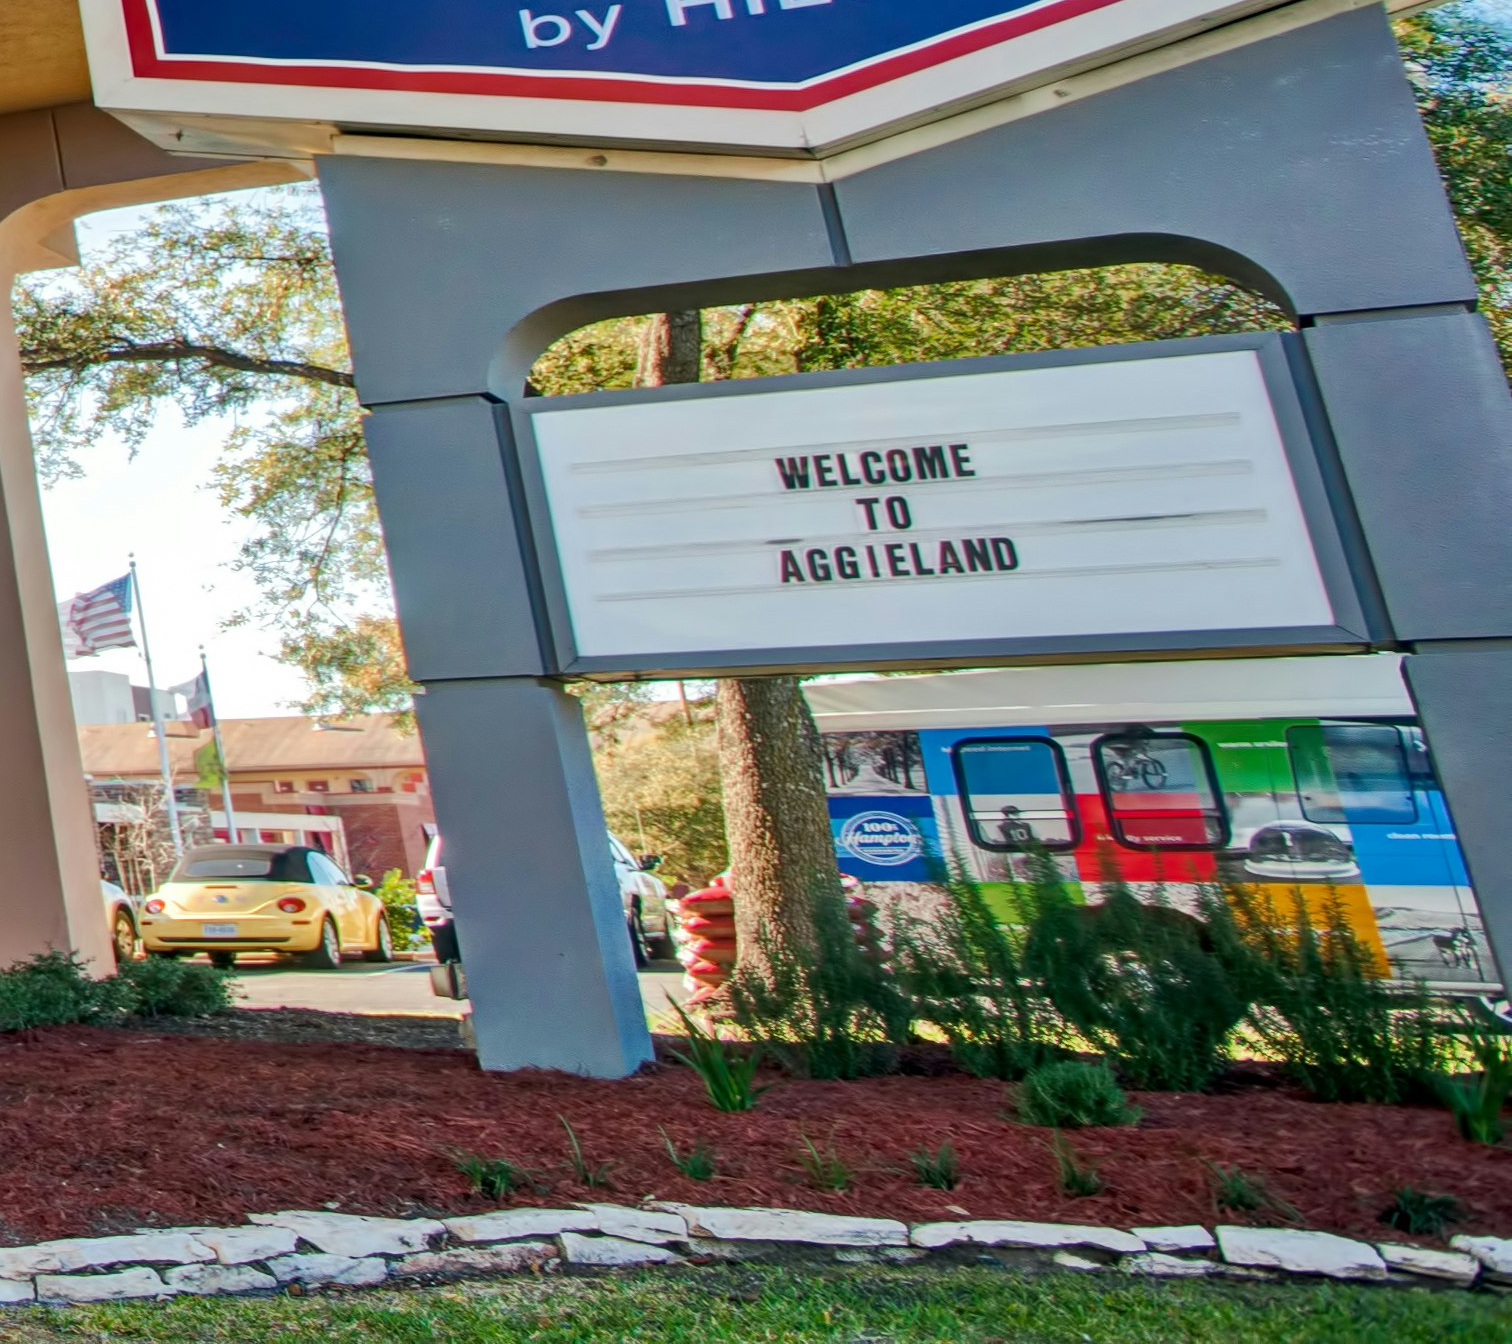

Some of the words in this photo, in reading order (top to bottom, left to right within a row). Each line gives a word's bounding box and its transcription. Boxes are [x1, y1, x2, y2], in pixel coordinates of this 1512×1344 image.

[519, 5, 622, 51] by
[775, 443, 976, 490] WELCOME
[855, 495, 913, 531] TO
